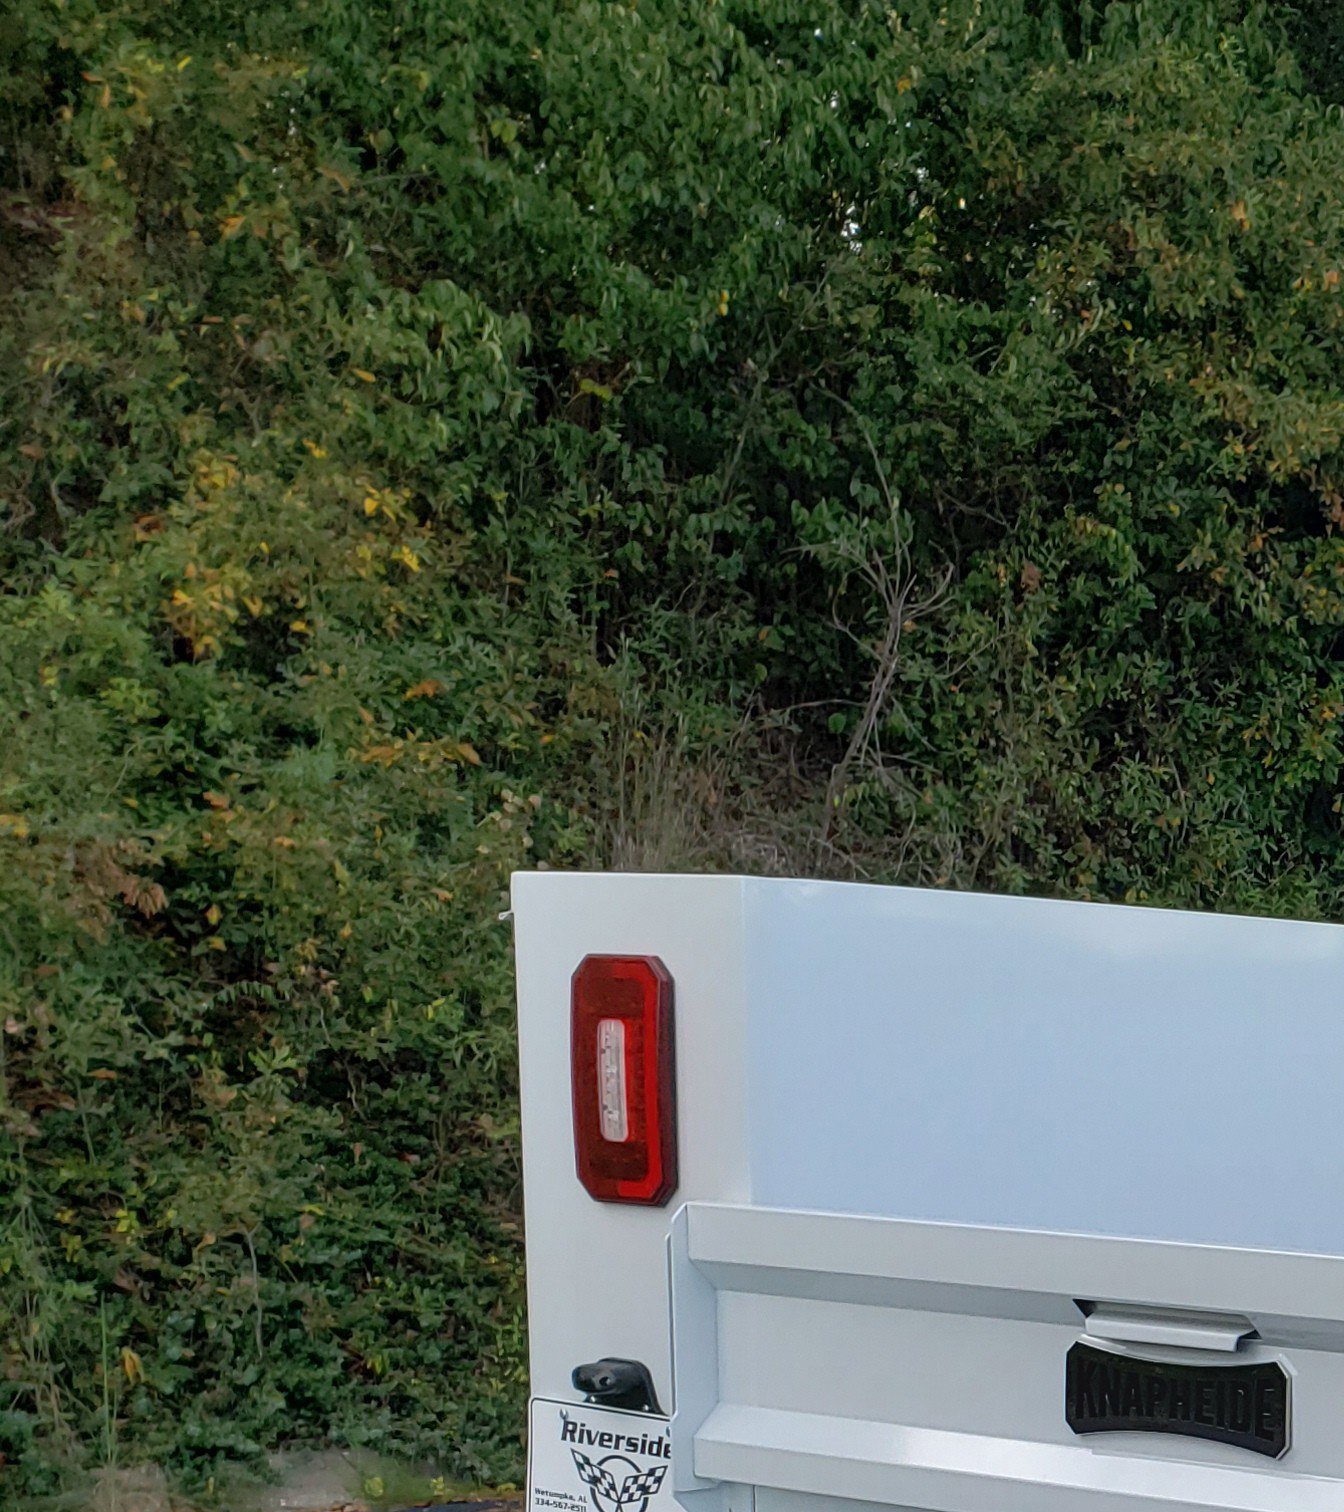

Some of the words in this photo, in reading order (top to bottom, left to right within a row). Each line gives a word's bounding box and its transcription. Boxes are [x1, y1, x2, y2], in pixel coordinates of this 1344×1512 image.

[1073, 1356, 1281, 1442] KNAPHEIDE
[561, 1419, 671, 1459] Riverside
[578, 1495, 588, 1504] AL
